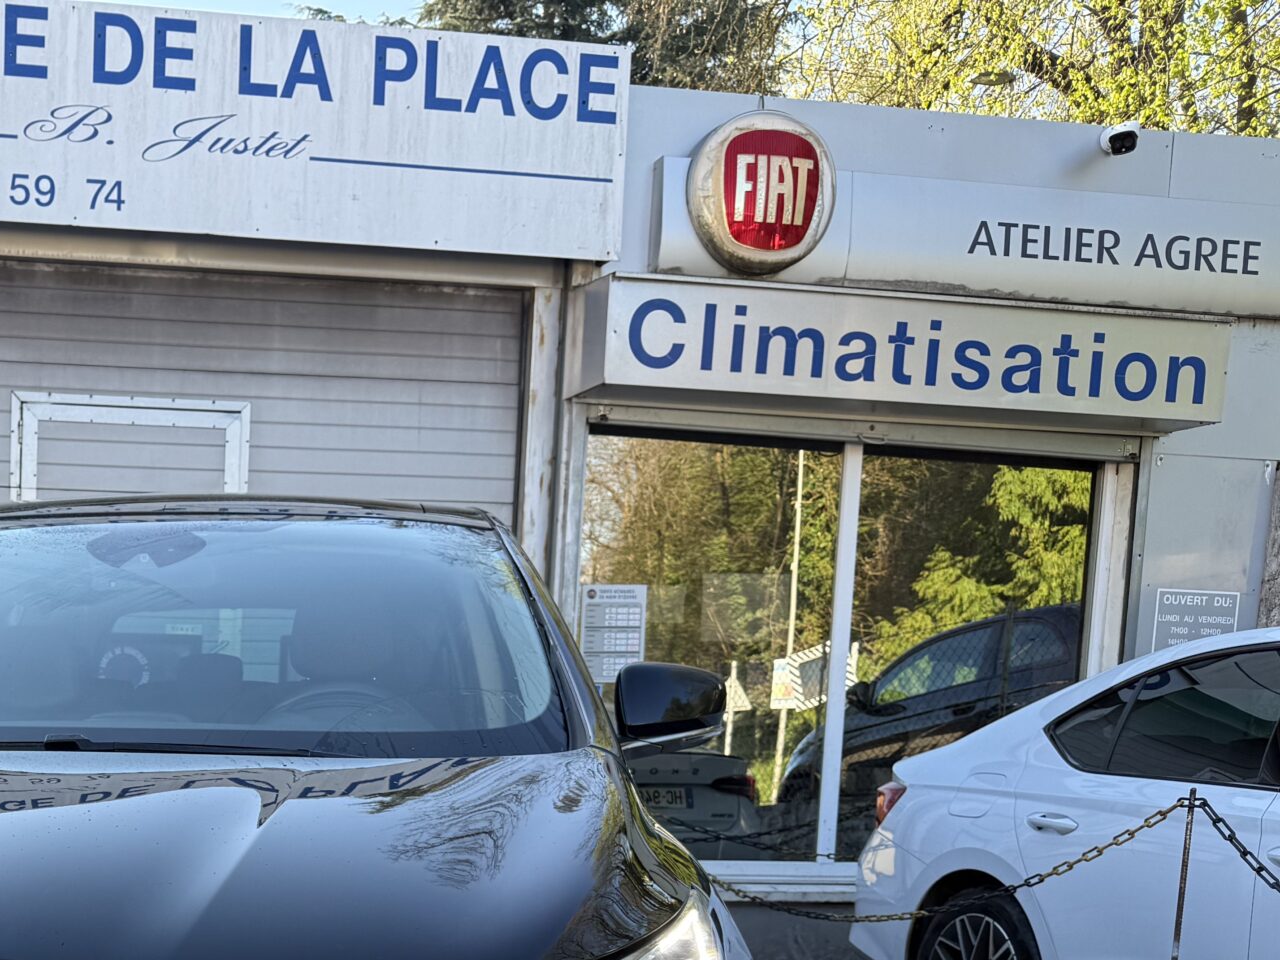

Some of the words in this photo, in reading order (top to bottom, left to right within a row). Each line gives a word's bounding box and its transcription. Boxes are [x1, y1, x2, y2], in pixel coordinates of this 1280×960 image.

[93, 11, 197, 91] DE
[237, 24, 333, 102] LA
[372, 35, 619, 124] PLACE
[23, 104, 115, 146] B.
[141, 114, 311, 162] Justet
[9, 174, 56, 207] 59
[86, 179, 125, 211] 74
[733, 152, 814, 227] FIAT
[967, 220, 1120, 265] ATELIER
[1134, 233, 1262, 275] AGREE
[628, 298, 1208, 405] Climatisation
[1158, 614, 1180, 622] LUNDI
[1198, 615, 1234, 624] VENDREDI
[1163, 594, 1208, 606] OUVERT
[1214, 596, 1233, 607] DU:
[1170, 626, 1188, 634] 7H00
